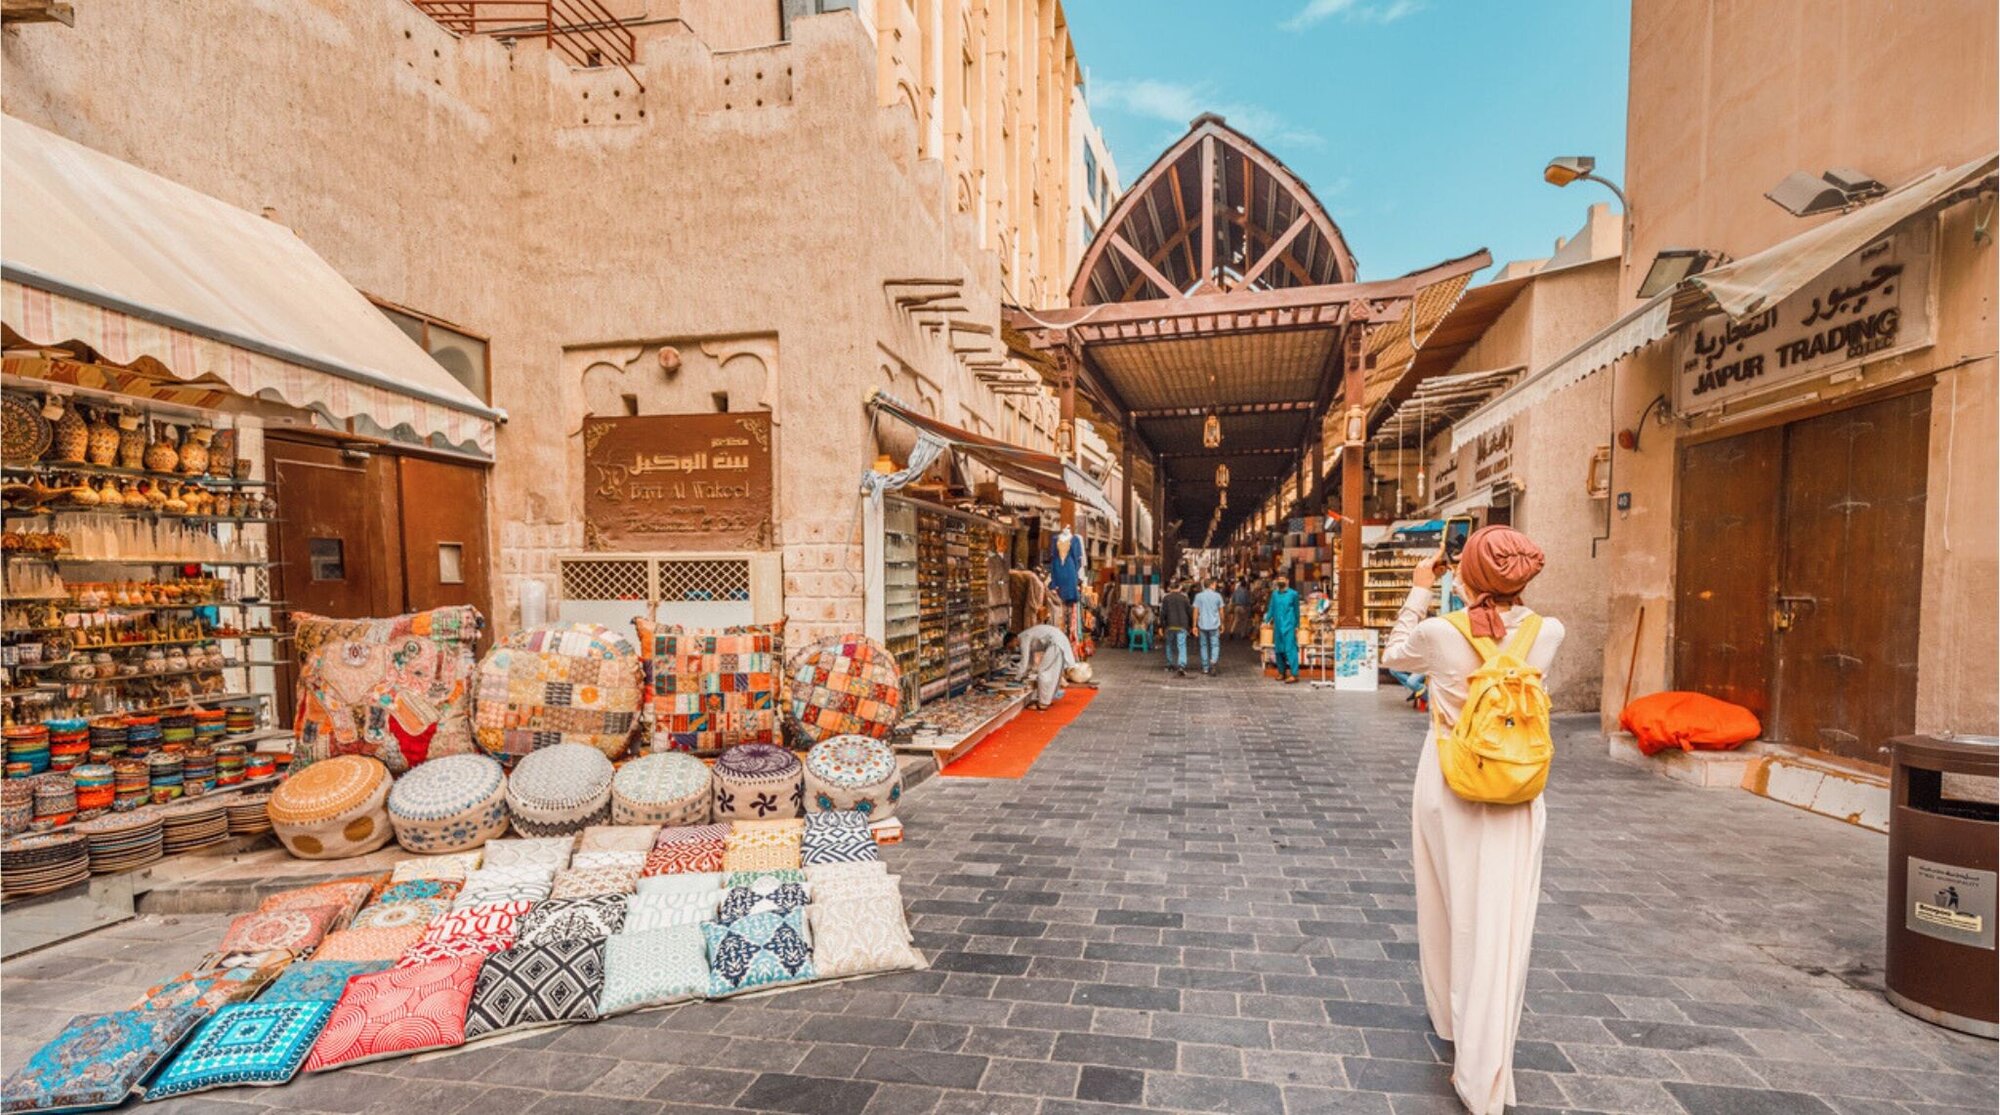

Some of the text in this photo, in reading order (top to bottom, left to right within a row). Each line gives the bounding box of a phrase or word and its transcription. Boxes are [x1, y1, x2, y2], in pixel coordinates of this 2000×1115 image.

[1693, 308, 1899, 395] JAIPUR TRADING
[629, 451, 749, 475] بيت الوكيل
[692, 481, 750, 499] Wakeel
